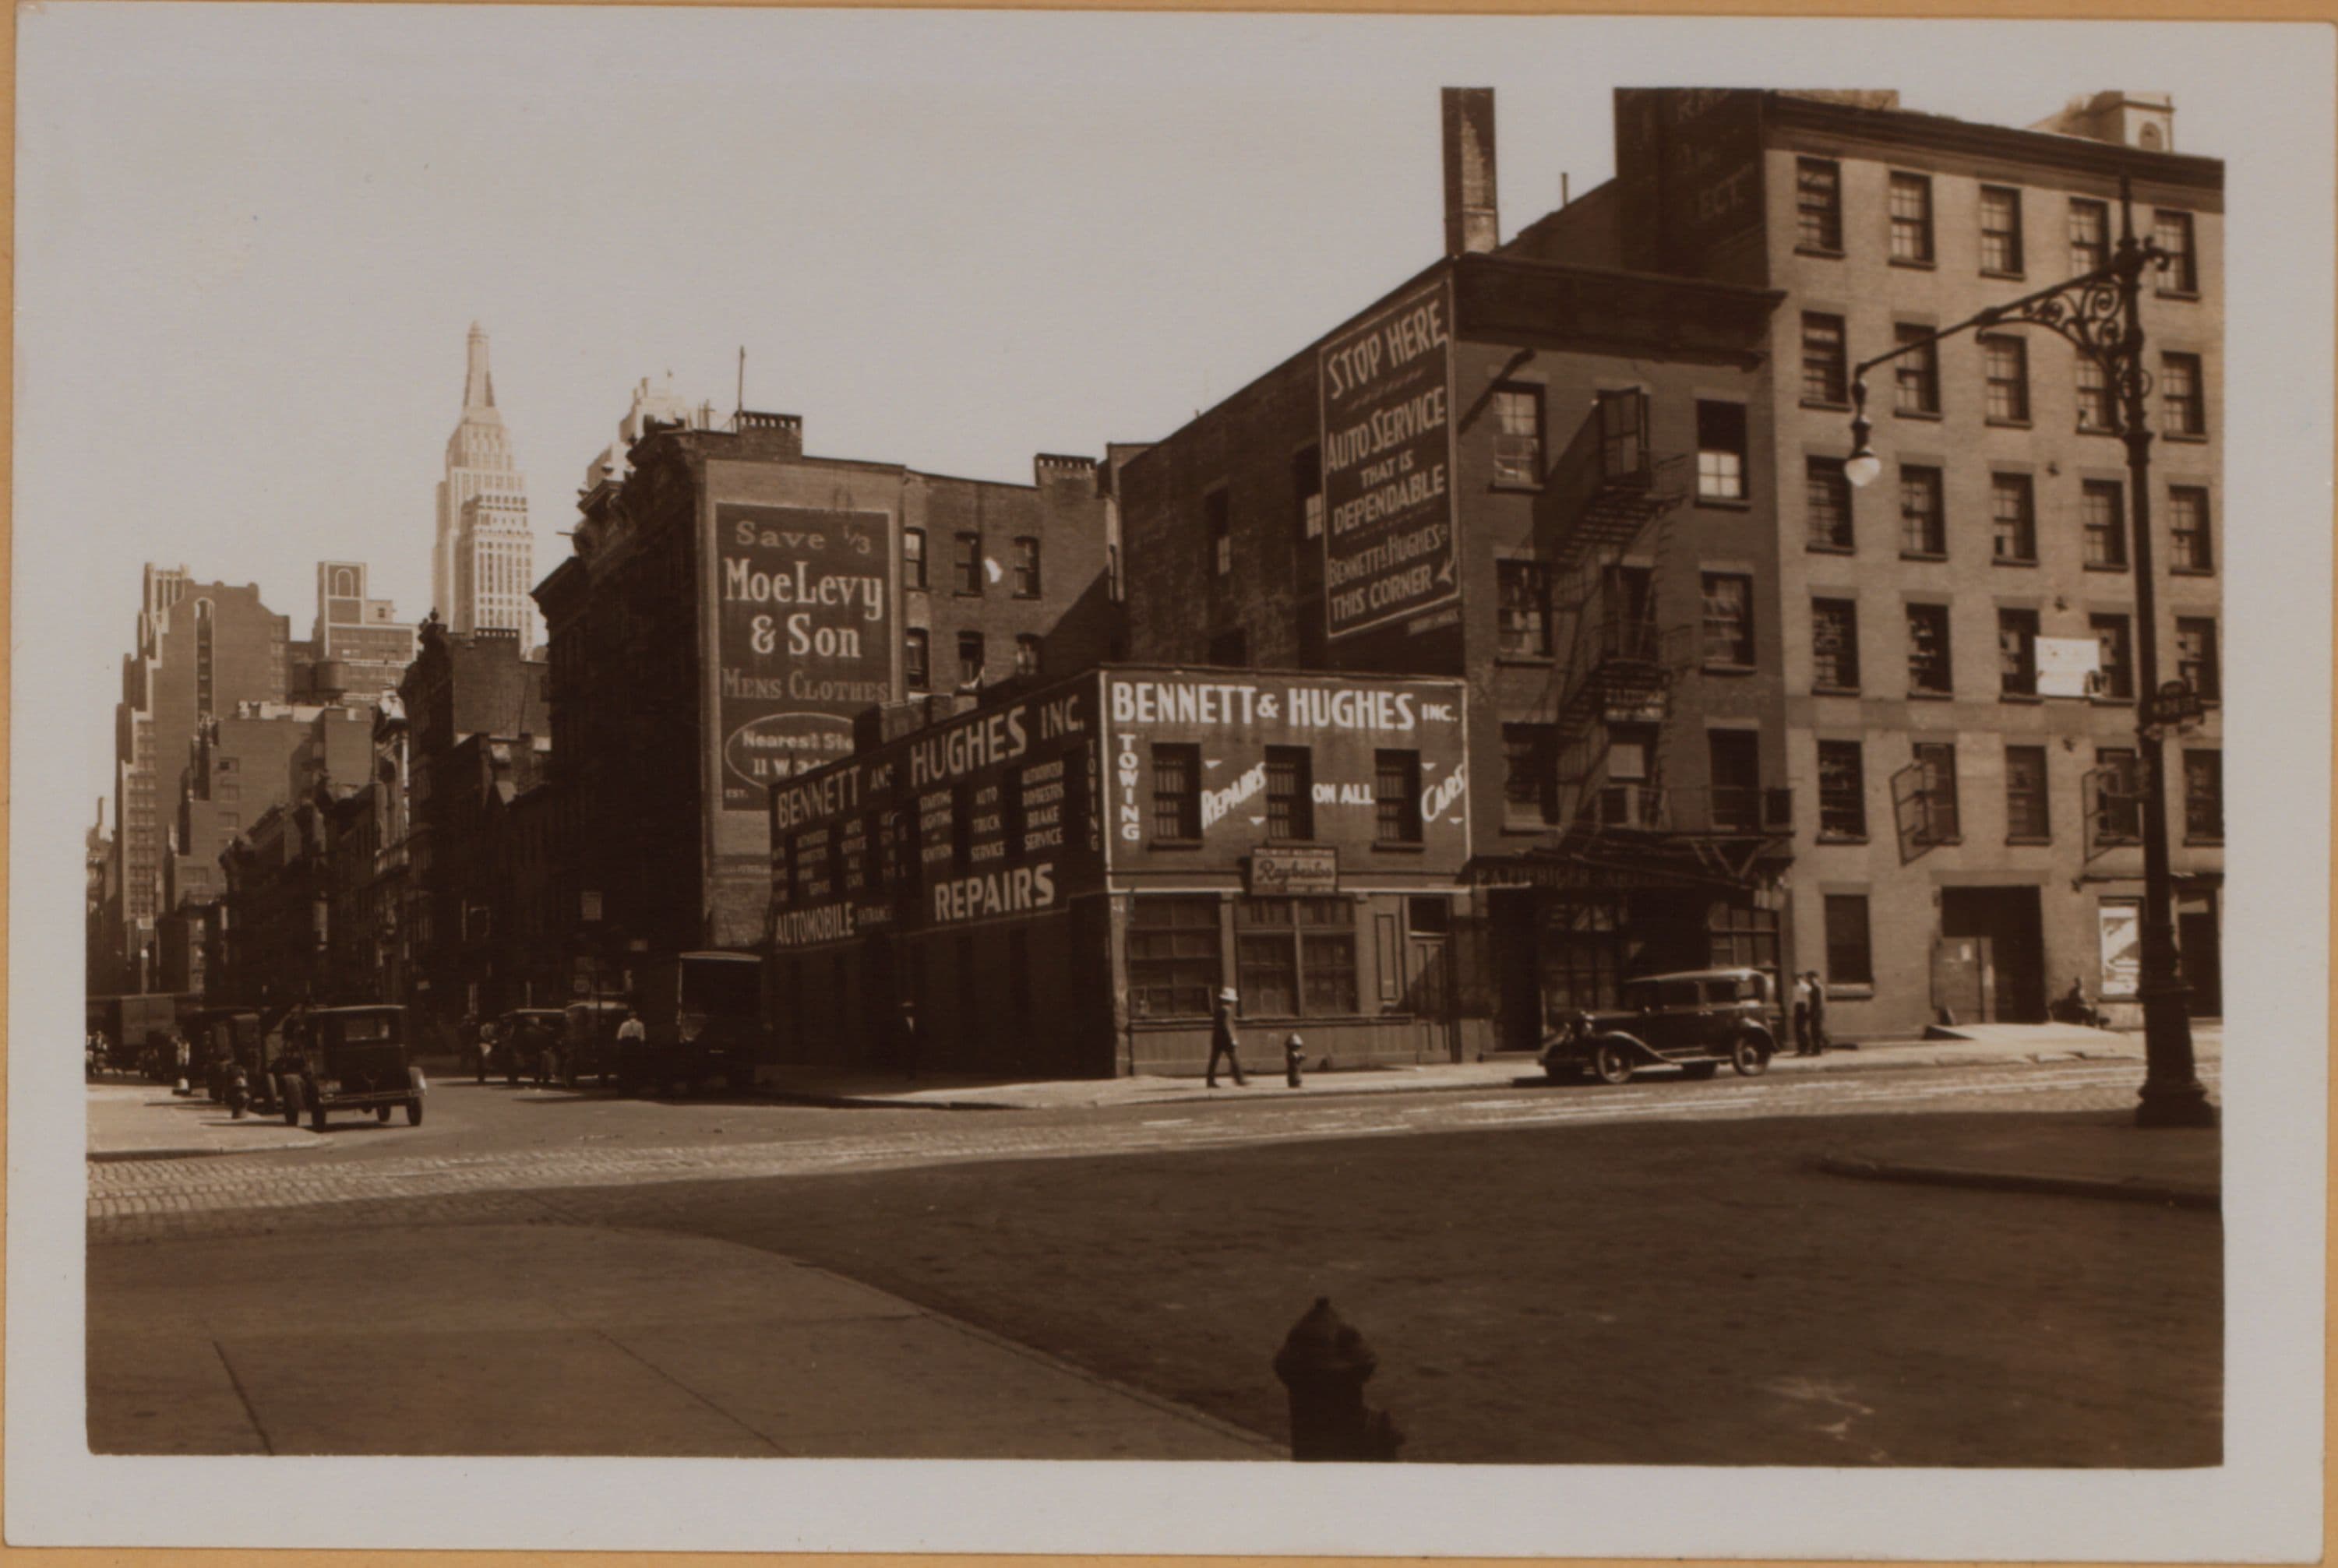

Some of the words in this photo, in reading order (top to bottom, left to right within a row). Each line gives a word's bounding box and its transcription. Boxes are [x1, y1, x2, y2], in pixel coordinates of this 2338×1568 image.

[1328, 330, 1382, 400] STOP
[1385, 298, 1449, 368] HERE
[1326, 423, 1370, 476] AUTO
[1371, 386, 1446, 453] SERVICE
[1360, 456, 1396, 489] THAT
[1399, 449, 1414, 473] IS
[1333, 463, 1445, 536] DEPENDABLE
[735, 520, 826, 549] Save
[1328, 546, 1379, 588] BENNETT
[1388, 524, 1441, 566] HUGHES
[1331, 587, 1366, 622] THIS
[1370, 563, 1433, 609] CORNER
[750, 615, 777, 654] &
[787, 612, 862, 658] Son
[1112, 682, 1257, 725] BENNETT
[1257, 692, 1279, 719] &
[1288, 688, 1416, 730] HUGHES
[1421, 703, 1458, 722] INC.
[742, 730, 818, 750] Nearest
[778, 763, 862, 829] BENNETT
[910, 704, 1028, 788] HUGHES
[1041, 694, 1085, 740] INC.
[1027, 804, 1060, 830] BRAKE
[1087, 738, 1099, 852] TOWING
[1117, 734, 1141, 842] TOWING
[1201, 760, 1268, 830] REPAIRS
[1312, 783, 1338, 805] ON
[1340, 783, 1376, 805] ALL
[1421, 763, 1465, 823] CARS
[971, 840, 1005, 862] SERVICE
[1024, 826, 1063, 851] SERVICE
[935, 862, 1056, 922] REPAIRS
[775, 900, 855, 946] AUTOMOBILE
